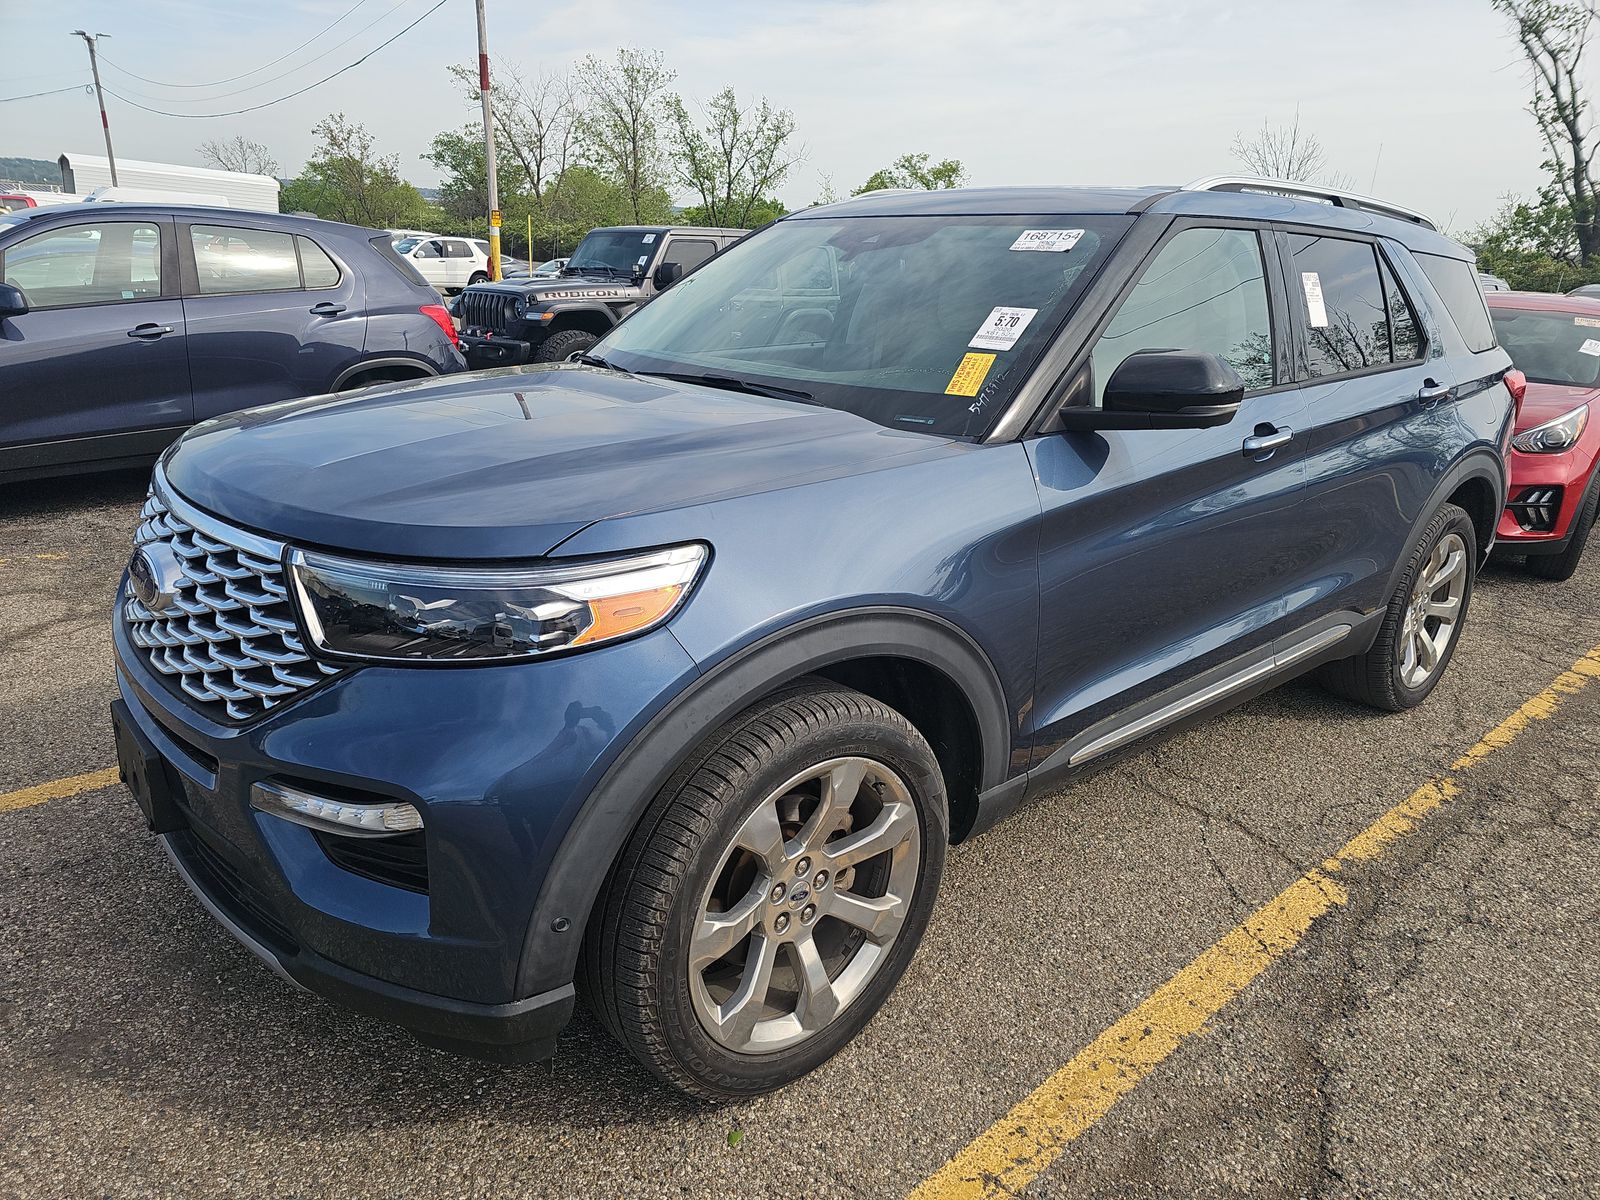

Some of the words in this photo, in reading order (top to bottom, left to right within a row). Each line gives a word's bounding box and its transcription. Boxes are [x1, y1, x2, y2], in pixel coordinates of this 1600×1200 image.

[1024, 231, 1081, 241] 1687154
[544, 290, 618, 299] RUBICON
[994, 315, 1020, 328] 5:70
[947, 379, 960, 393] THIS
[956, 356, 974, 378] VEHICLE
[957, 382, 966, 393] NOT
[962, 371, 971, 381] FOR
[969, 357, 978, 370] SALE
